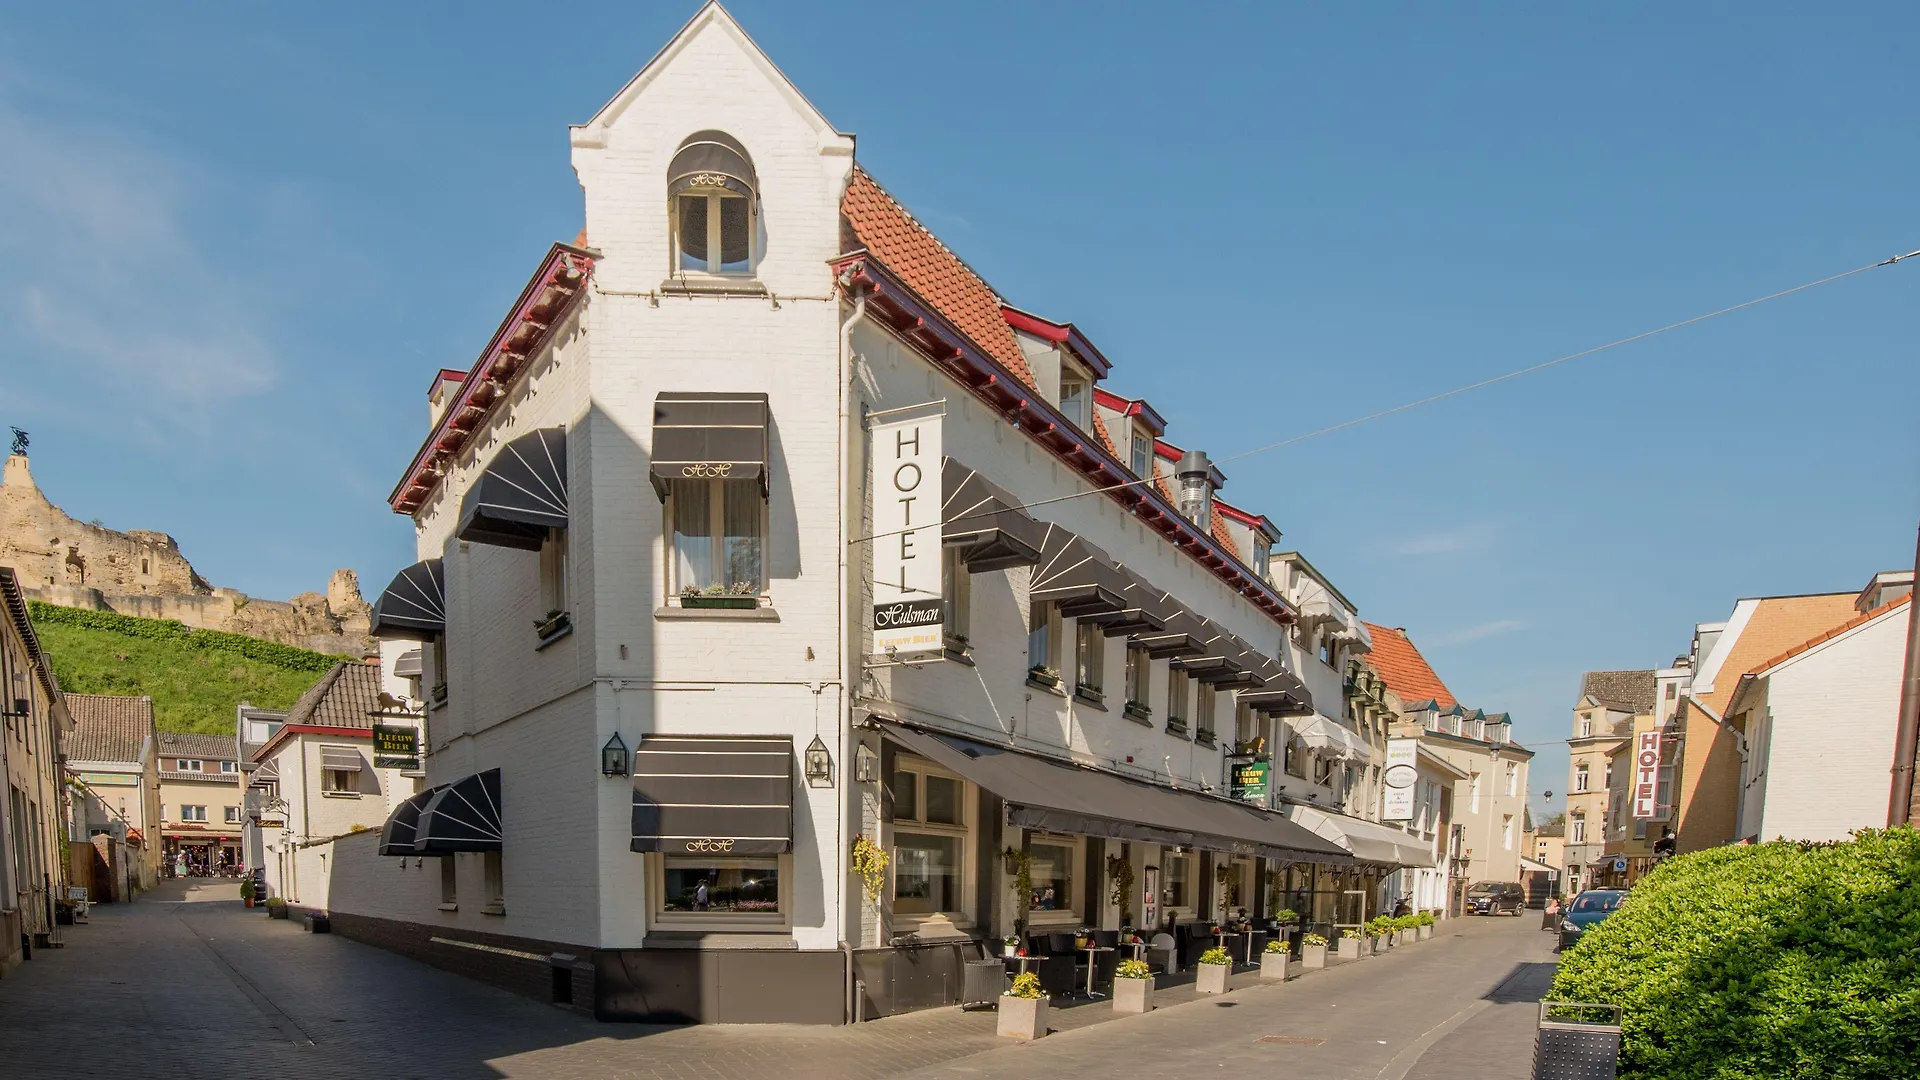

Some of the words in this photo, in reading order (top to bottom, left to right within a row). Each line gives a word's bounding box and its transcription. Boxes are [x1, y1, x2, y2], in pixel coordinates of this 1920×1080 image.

[894, 427, 922, 593] HOTEL
[875, 603, 939, 626] Hulsman
[1637, 734, 1657, 815] HOTEL
